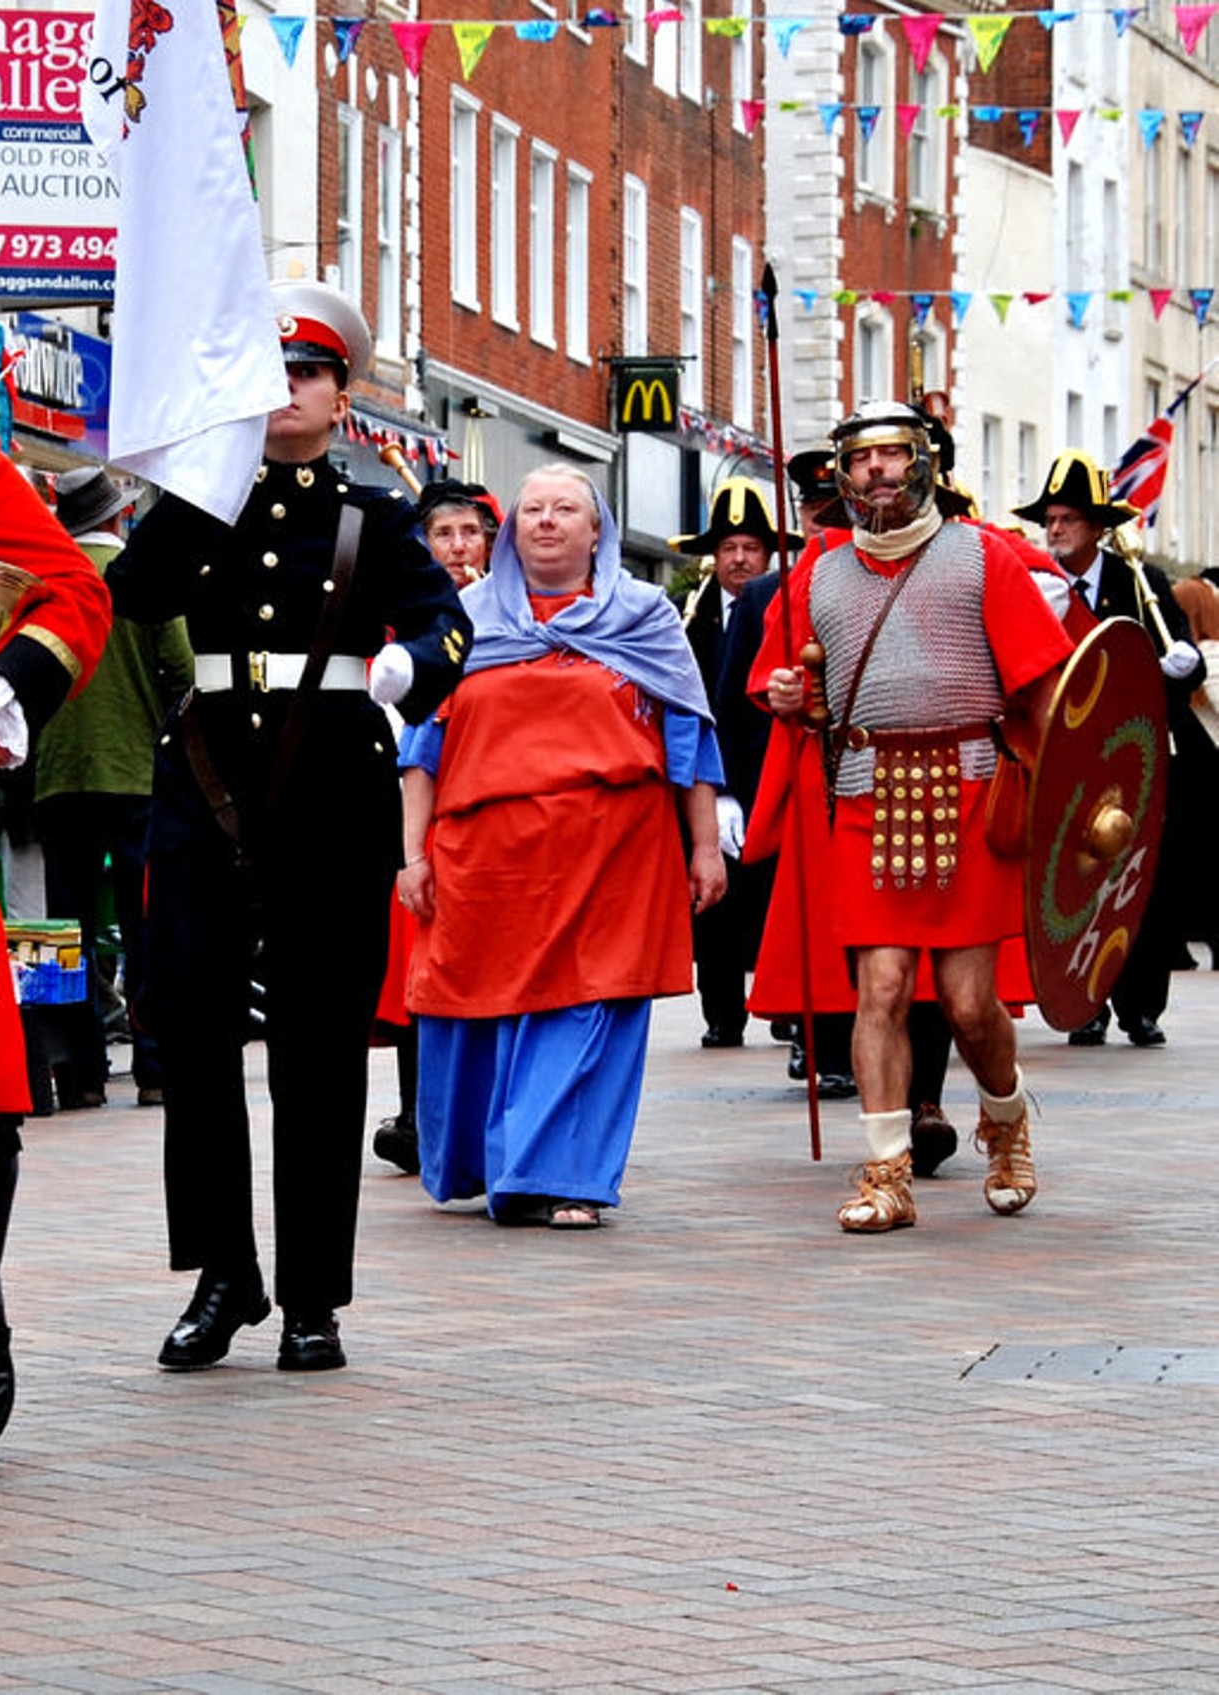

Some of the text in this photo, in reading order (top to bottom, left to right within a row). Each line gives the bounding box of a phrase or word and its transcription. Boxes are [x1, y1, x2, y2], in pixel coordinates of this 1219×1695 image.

[2, 125, 81, 141] commercial
[51, 149, 90, 167] FOR
[1, 174, 122, 199] AUCTION
[11, 234, 62, 259] 973
